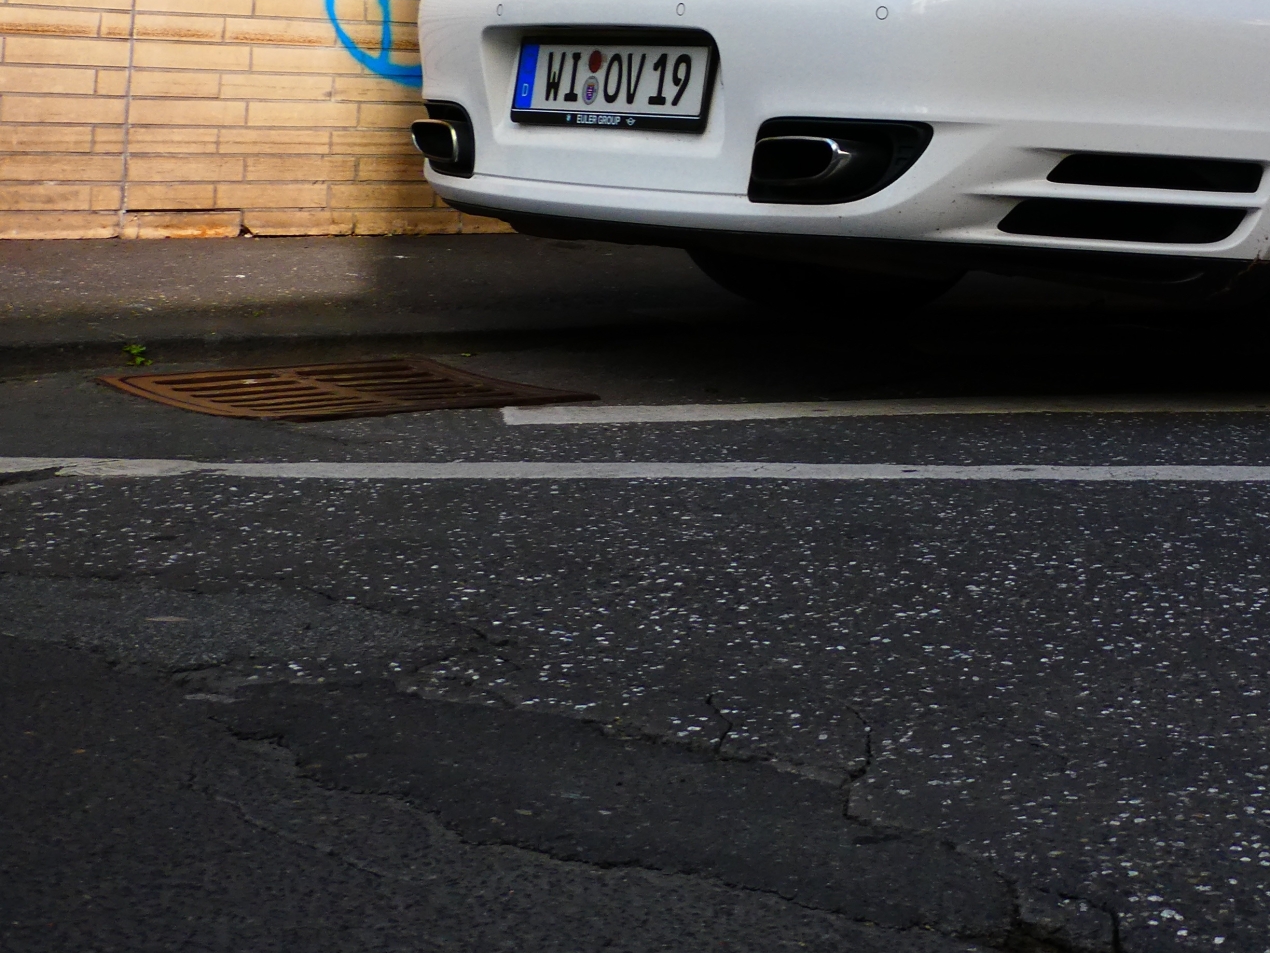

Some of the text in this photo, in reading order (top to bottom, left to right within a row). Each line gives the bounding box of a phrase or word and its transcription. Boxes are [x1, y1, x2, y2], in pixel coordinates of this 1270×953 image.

[545, 51, 582, 102] WI
[521, 83, 529, 97] D
[576, 114, 620, 125] EULER GROUP
